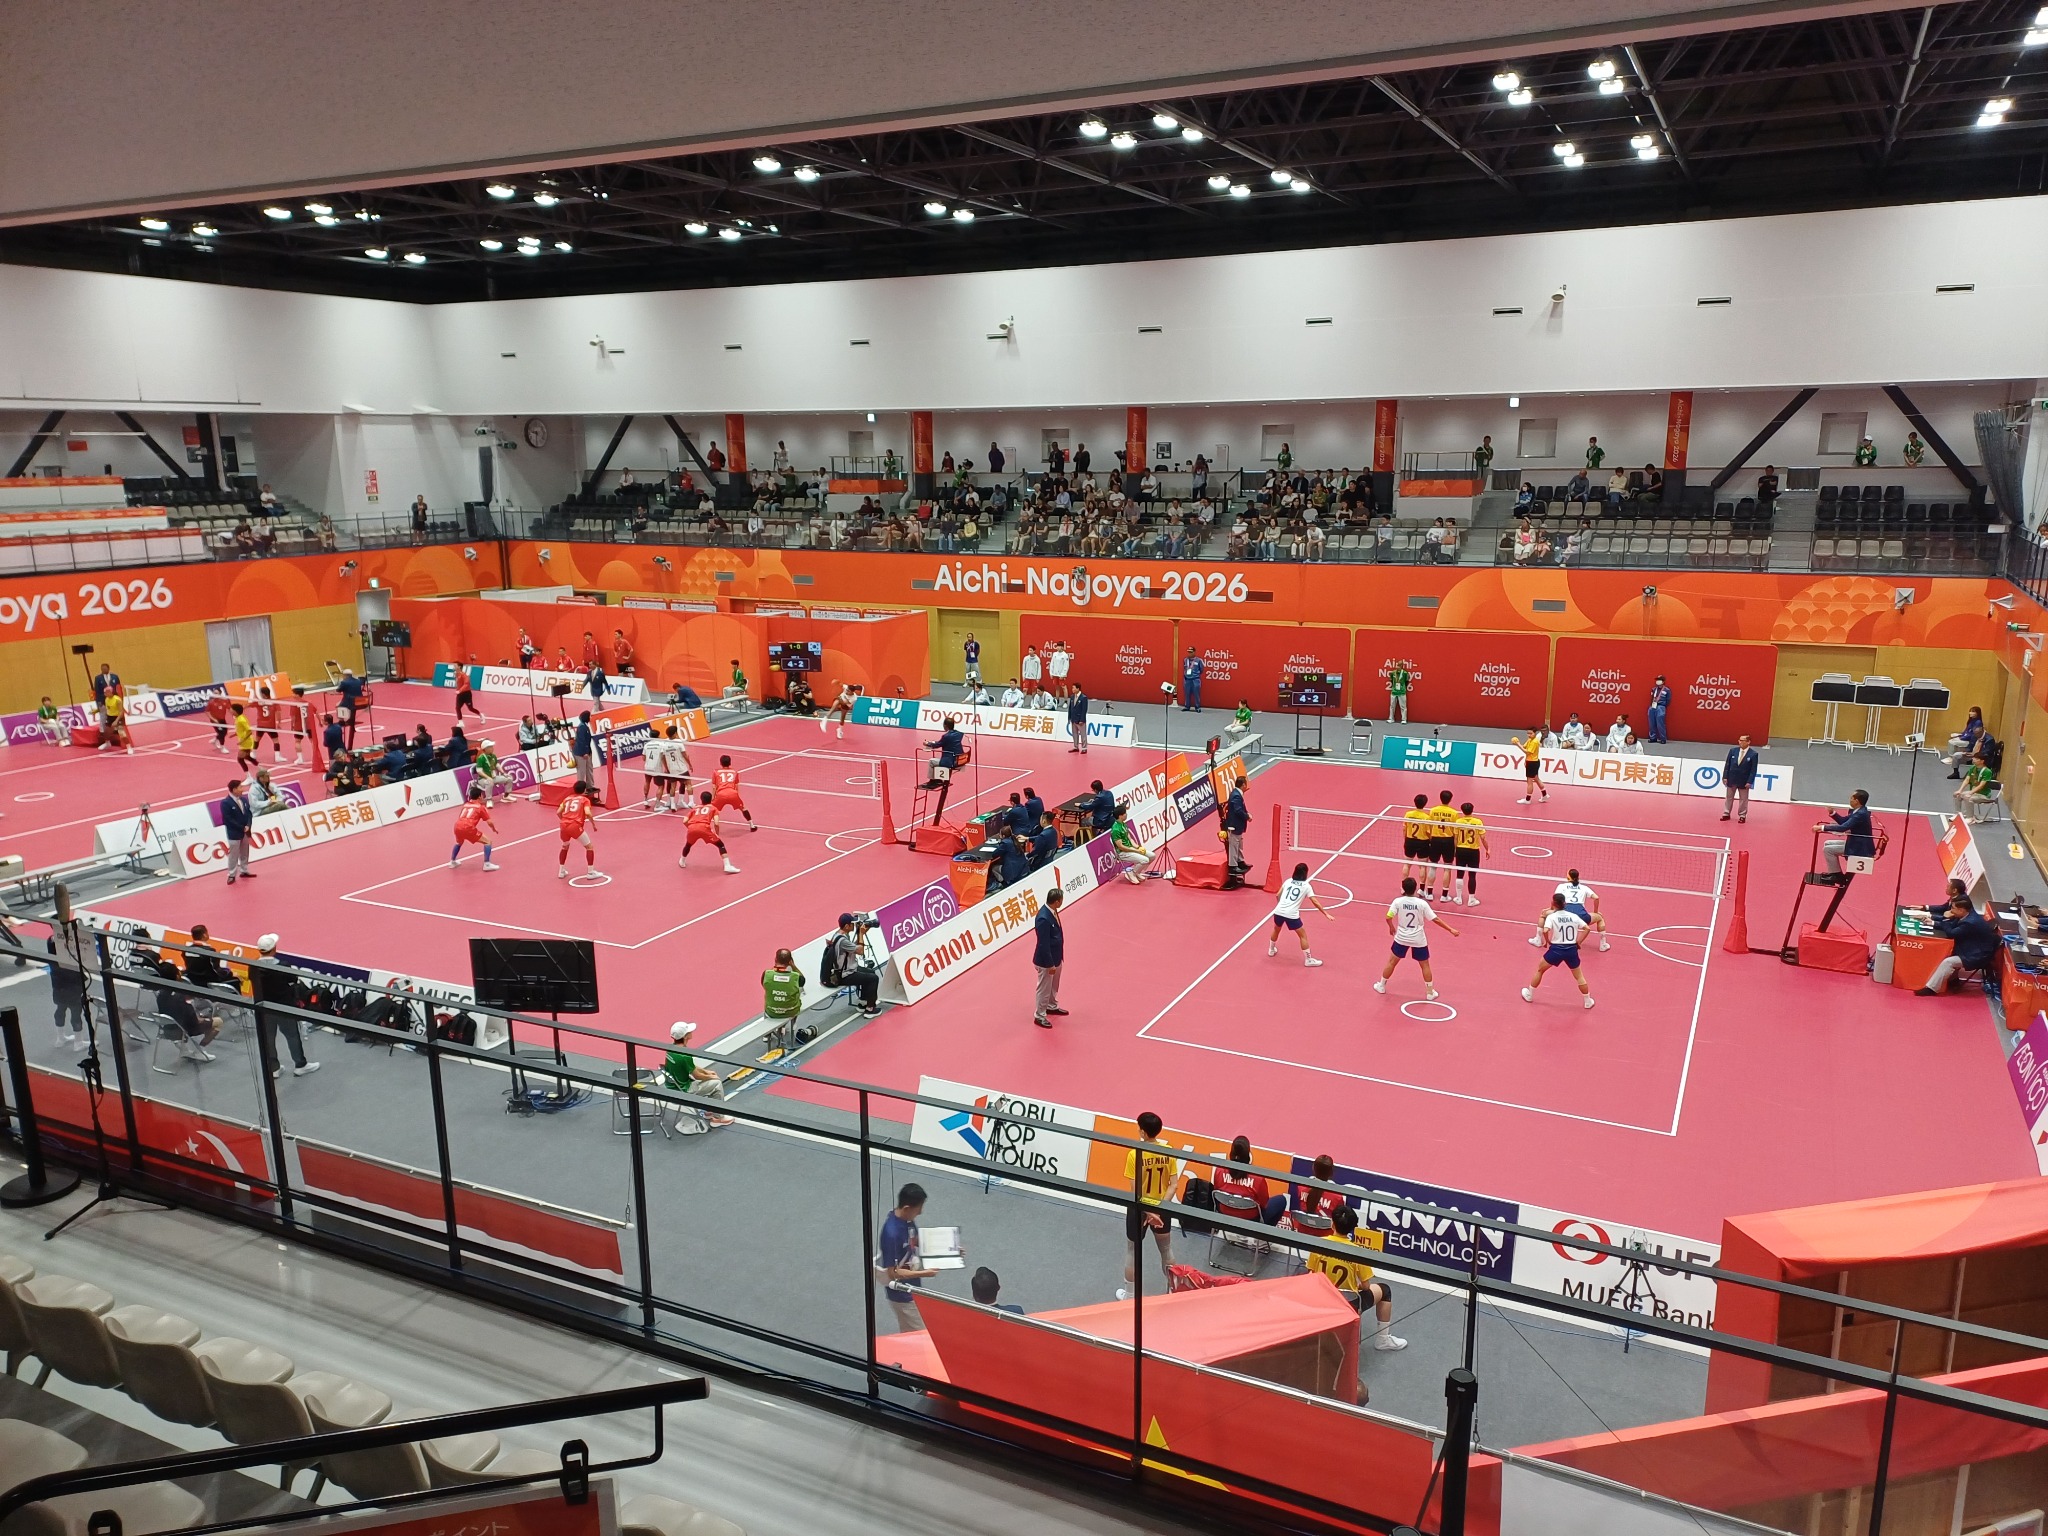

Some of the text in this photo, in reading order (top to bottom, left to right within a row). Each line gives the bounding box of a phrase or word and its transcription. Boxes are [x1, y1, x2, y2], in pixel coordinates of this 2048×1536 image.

[934, 560, 1248, 607] Aichi-Nagoya 2026
[78, 577, 173, 617] 2026
[1119, 644, 1148, 655] Aichi-
[1204, 649, 1234, 660] Aichi-
[1115, 653, 1152, 666] Nagoya
[1201, 659, 1238, 672] Nagoya
[1288, 653, 1321, 665] Aichi-
[1121, 665, 1146, 676] 2026
[1205, 670, 1231, 681] 2026
[1480, 662, 1516, 674] Aichi-
[1587, 668, 1626, 680] Aichi-
[485, 673, 530, 688] TOYOTA
[1385, 681, 1414, 692] 26
[1473, 673, 1520, 687] Nagoya
[1581, 679, 1631, 693] Nagoya
[1695, 674, 1737, 686] Aichi-
[1480, 686, 1511, 697] 2026
[1588, 692, 1621, 705] 2026
[1688, 684, 1742, 699] Nagoya
[869, 697, 903, 715] ニトリ
[1696, 699, 1731, 711] 2026
[867, 715, 900, 726] NITORI
[921, 708, 983, 727] TOYOTA
[989, 712, 1055, 735] JR東海
[1087, 721, 1124, 739] NTT
[1405, 739, 1452, 758] ニトリ
[535, 750, 572, 774] DEN
[1403, 758, 1450, 774] NITORI
[1480, 751, 1569, 776] TOYTA
[939, 770, 945, 778] 2
[1578, 757, 1676, 787] JR東海
[1177, 781, 1213, 813] BORNAN
[459, 806, 474, 819] 11
[563, 799, 579, 813] 15
[292, 799, 375, 841] JR東海
[1138, 804, 1177, 845] DENSO
[1411, 823, 1419, 838] 2
[1460, 829, 1476, 845] 13
[185, 826, 285, 866] Caon
[1856, 860, 1865, 871] 3
[1285, 885, 1301, 902] 19
[1569, 890, 1579, 903] 3
[928, 898, 952, 926] 100
[1402, 903, 1418, 911] INDIA
[978, 887, 1039, 947] JR東海
[1405, 912, 1416, 929] 2
[1558, 925, 1575, 943] 10
[903, 928, 977, 988] Canon
[1146, 1167, 1164, 1195] 11
[1377, 1227, 1502, 1269] TECHNOLOGY
[1653, 1298, 1715, 1331] Bank
